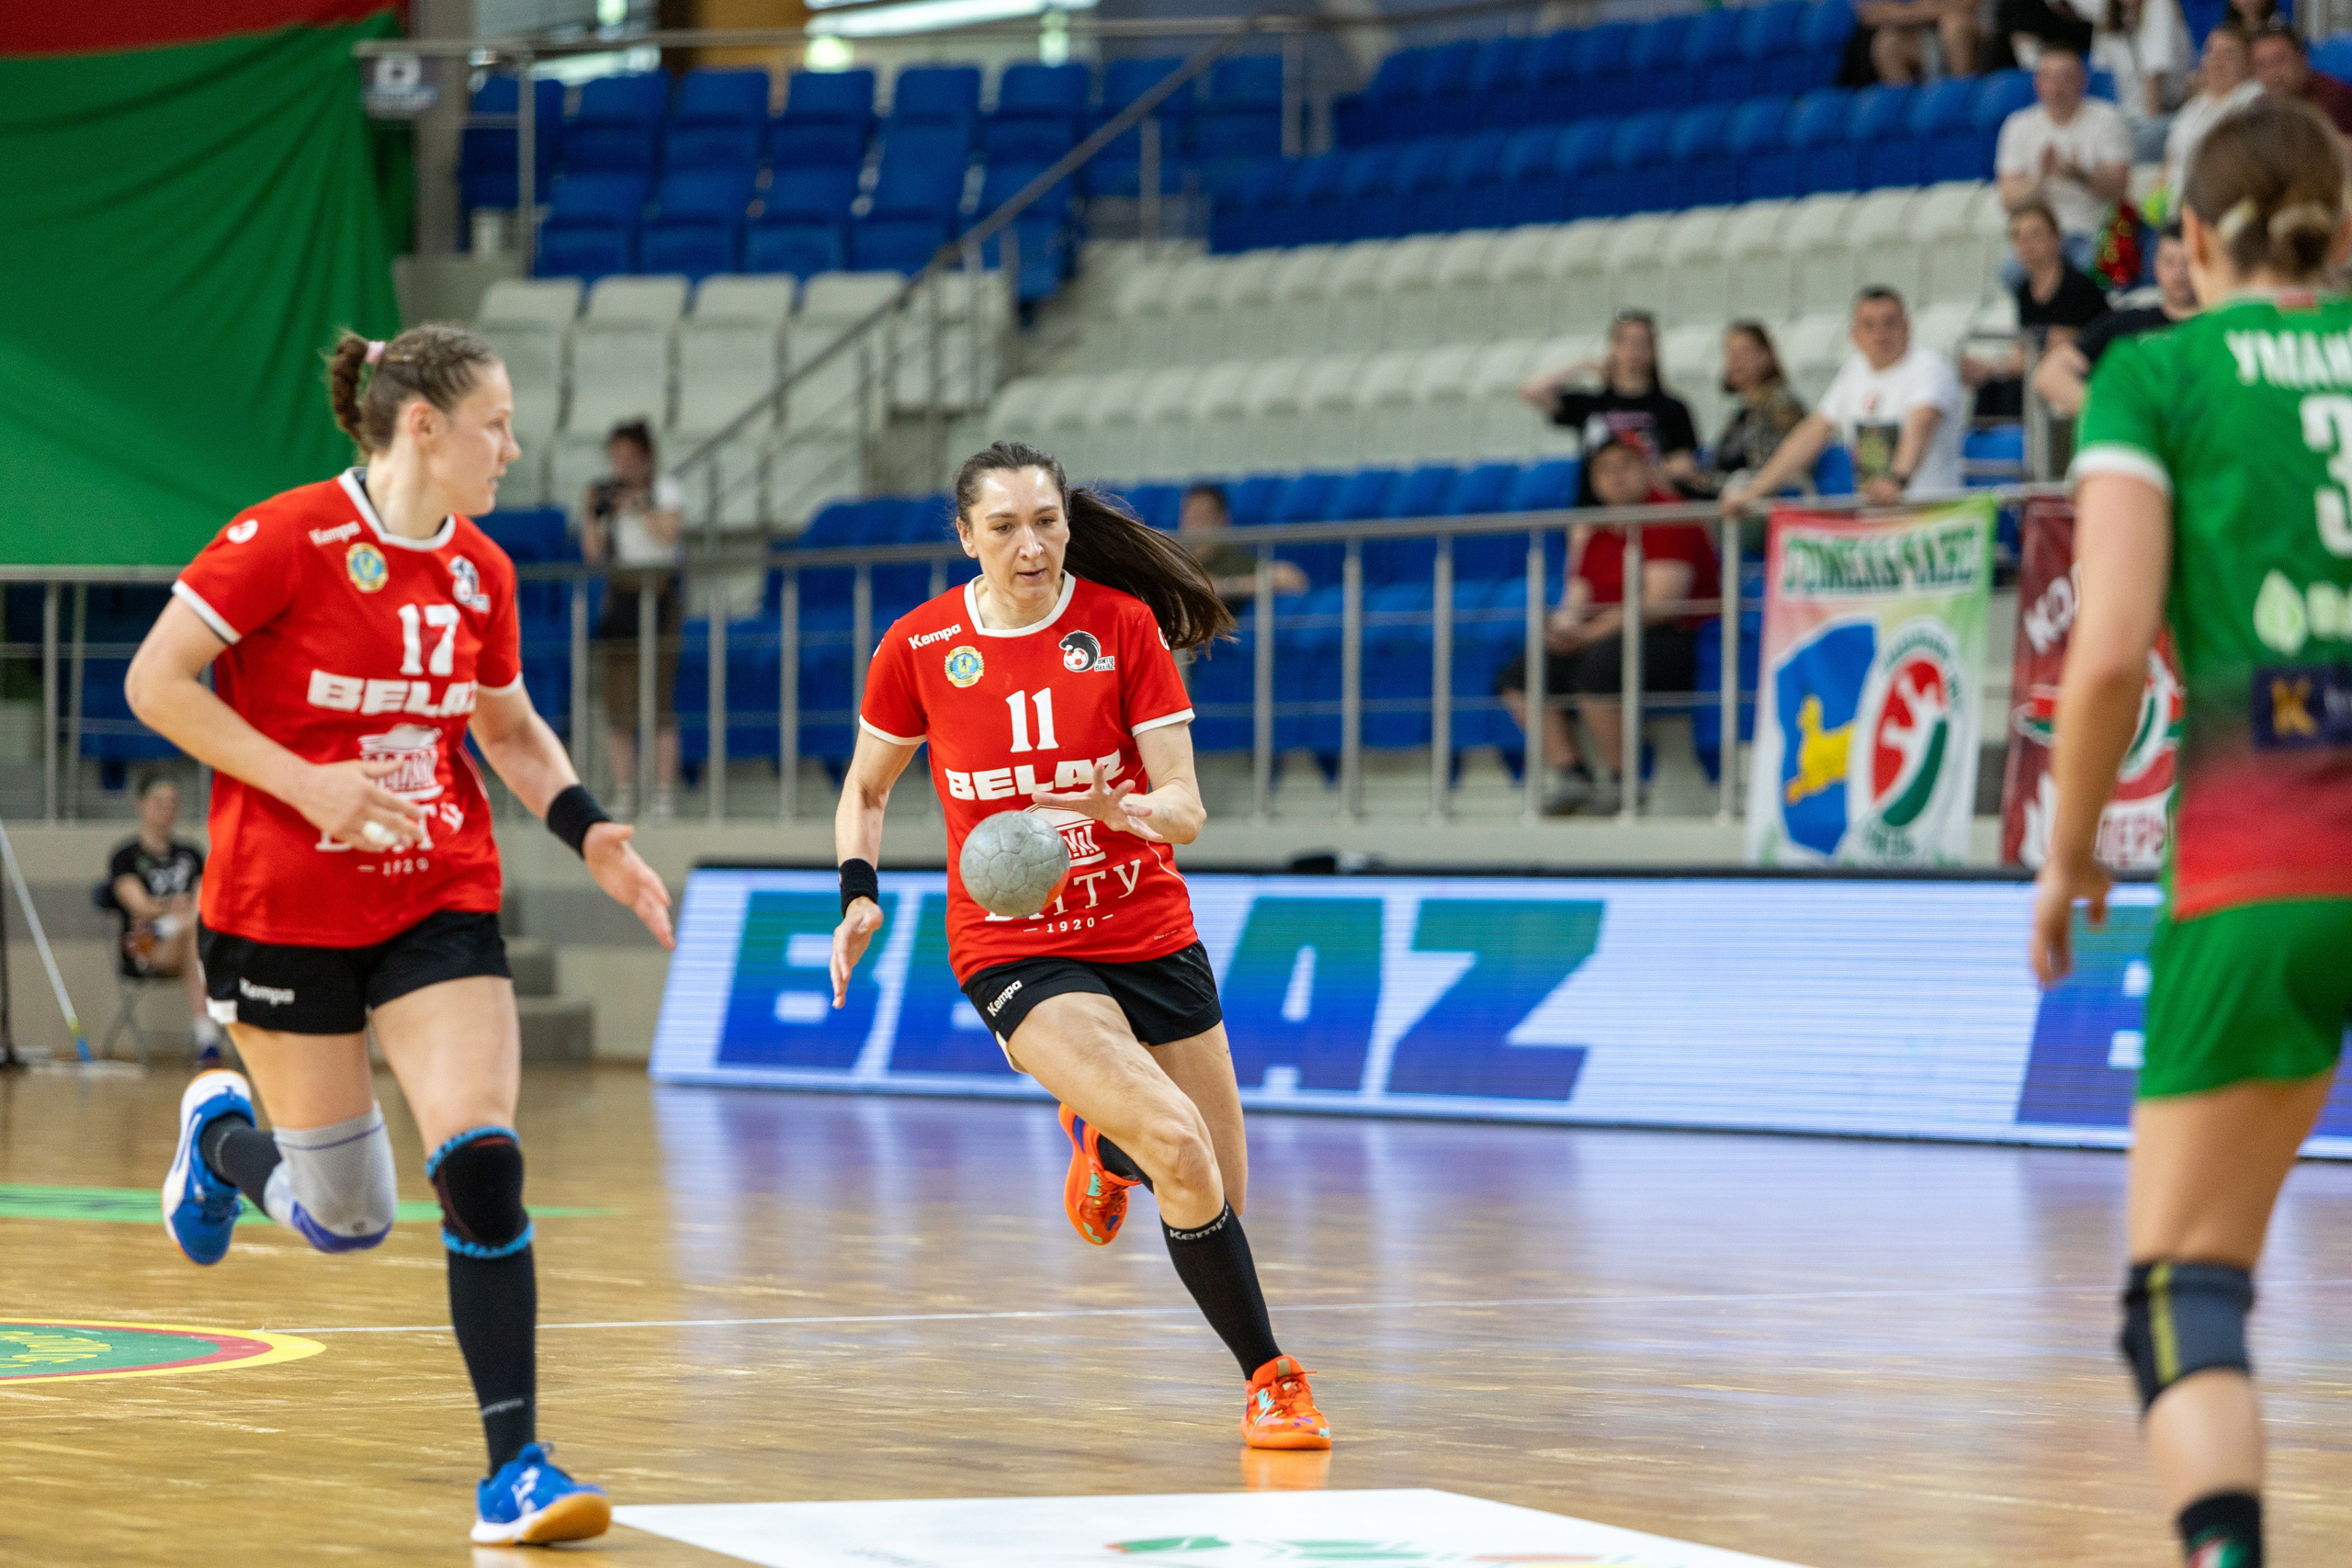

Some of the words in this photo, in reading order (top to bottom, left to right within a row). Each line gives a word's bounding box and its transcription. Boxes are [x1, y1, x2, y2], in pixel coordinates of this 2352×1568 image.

[397, 604, 460, 675] 17
[908, 624, 962, 649] Kempa
[307, 669, 477, 717] BELA
[1006, 688, 1059, 753] 11
[944, 749, 1125, 801] BELAZ
[1046, 917, 1095, 932] 1920
[987, 979, 1023, 1017] Kempa
